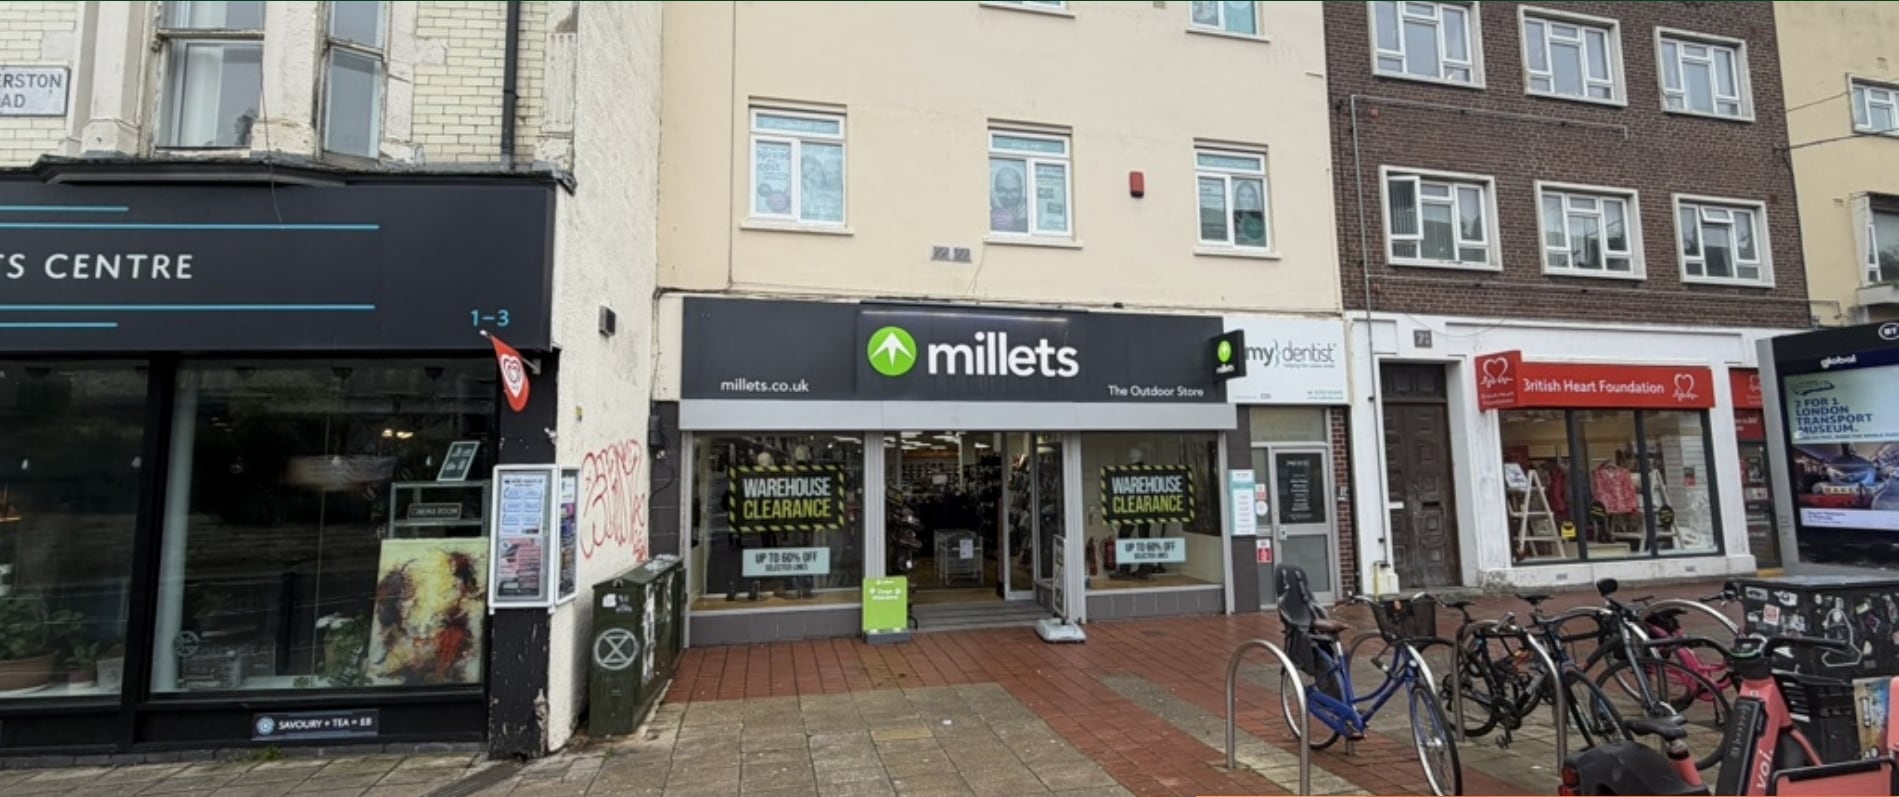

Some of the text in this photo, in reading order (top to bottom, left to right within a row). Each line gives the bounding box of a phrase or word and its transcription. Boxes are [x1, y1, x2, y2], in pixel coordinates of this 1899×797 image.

[0, 73, 62, 88] RSTON
[0, 253, 193, 279] S CENTRE
[1884, 327, 1897, 335] BT
[928, 331, 1080, 378] millets
[1820, 353, 1857, 369] global
[720, 378, 809, 393] millets.co.uk
[1108, 385, 1204, 397] The Outdoor Store
[1523, 378, 1665, 395] British Heart Foundation
[1795, 397, 1839, 408] 2 FOR 1
[1796, 406, 1850, 417] LONDON
[1796, 413, 1873, 425] TRANSPORT
[743, 477, 832, 498] WAREHOUSE
[1111, 475, 1183, 494] WAREHOUSE
[743, 498, 832, 519] CLEARANCE
[1113, 494, 1184, 513] CLEARANCE
[1125, 542, 1135, 552] UP
[1163, 541, 1176, 552] OFF
[755, 552, 767, 564] UP
[769, 552, 779, 563] TO
[802, 551, 818, 562] OFF
[278, 719, 322, 730] SAVOURY
[332, 718, 351, 728] TEA
